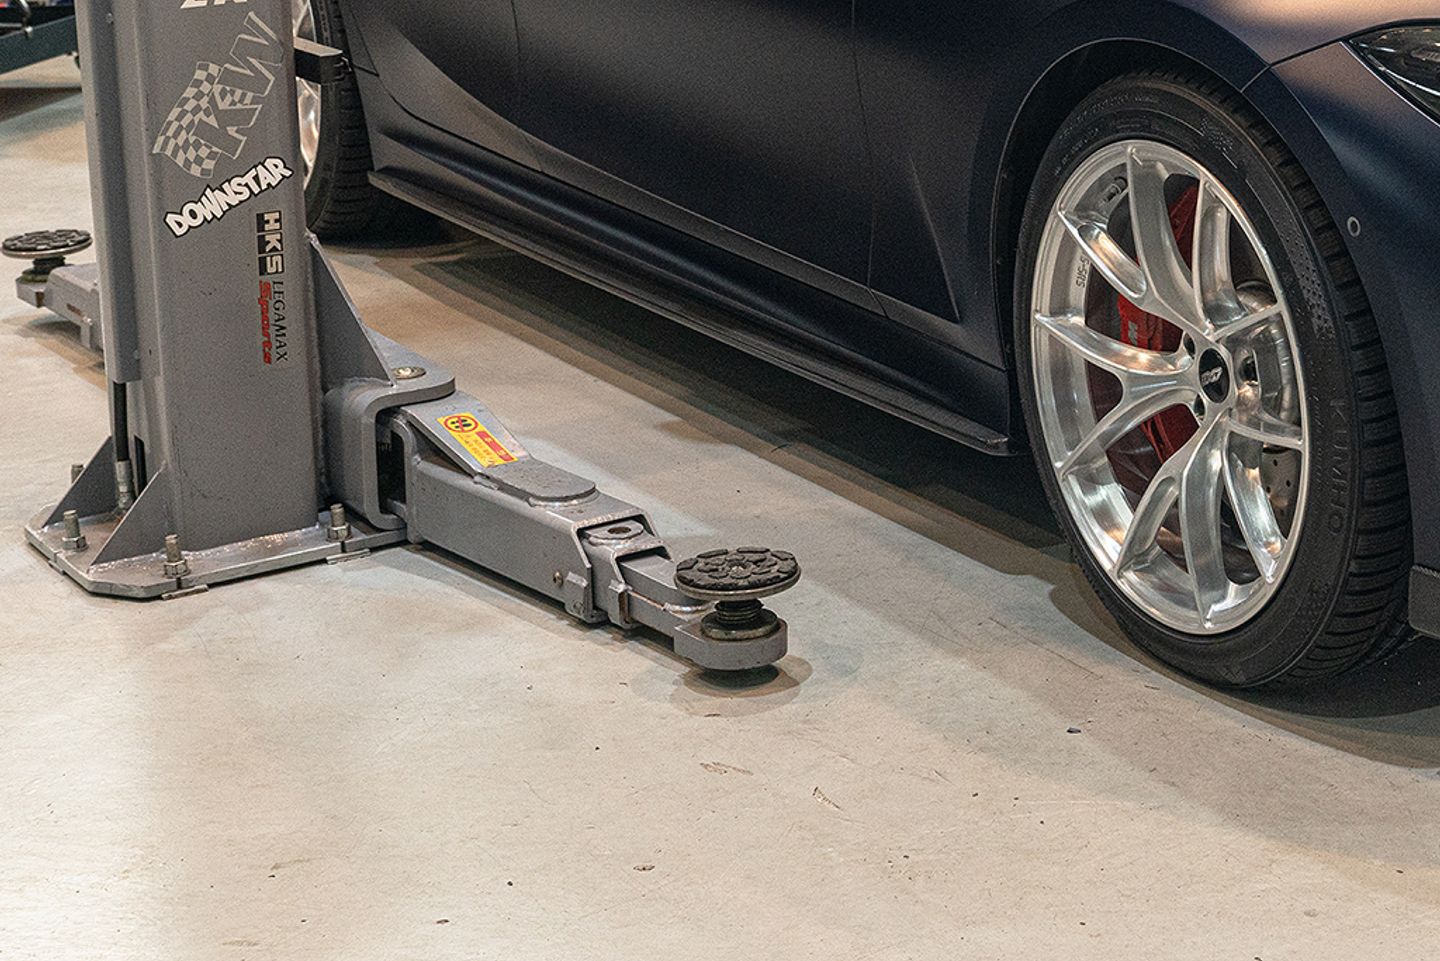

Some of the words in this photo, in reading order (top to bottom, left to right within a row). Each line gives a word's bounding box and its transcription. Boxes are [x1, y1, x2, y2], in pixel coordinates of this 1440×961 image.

[165, 157, 293, 237] DOWNSTAR
[260, 211, 284, 275] HKS
[272, 280, 289, 363] LEGAMAX
